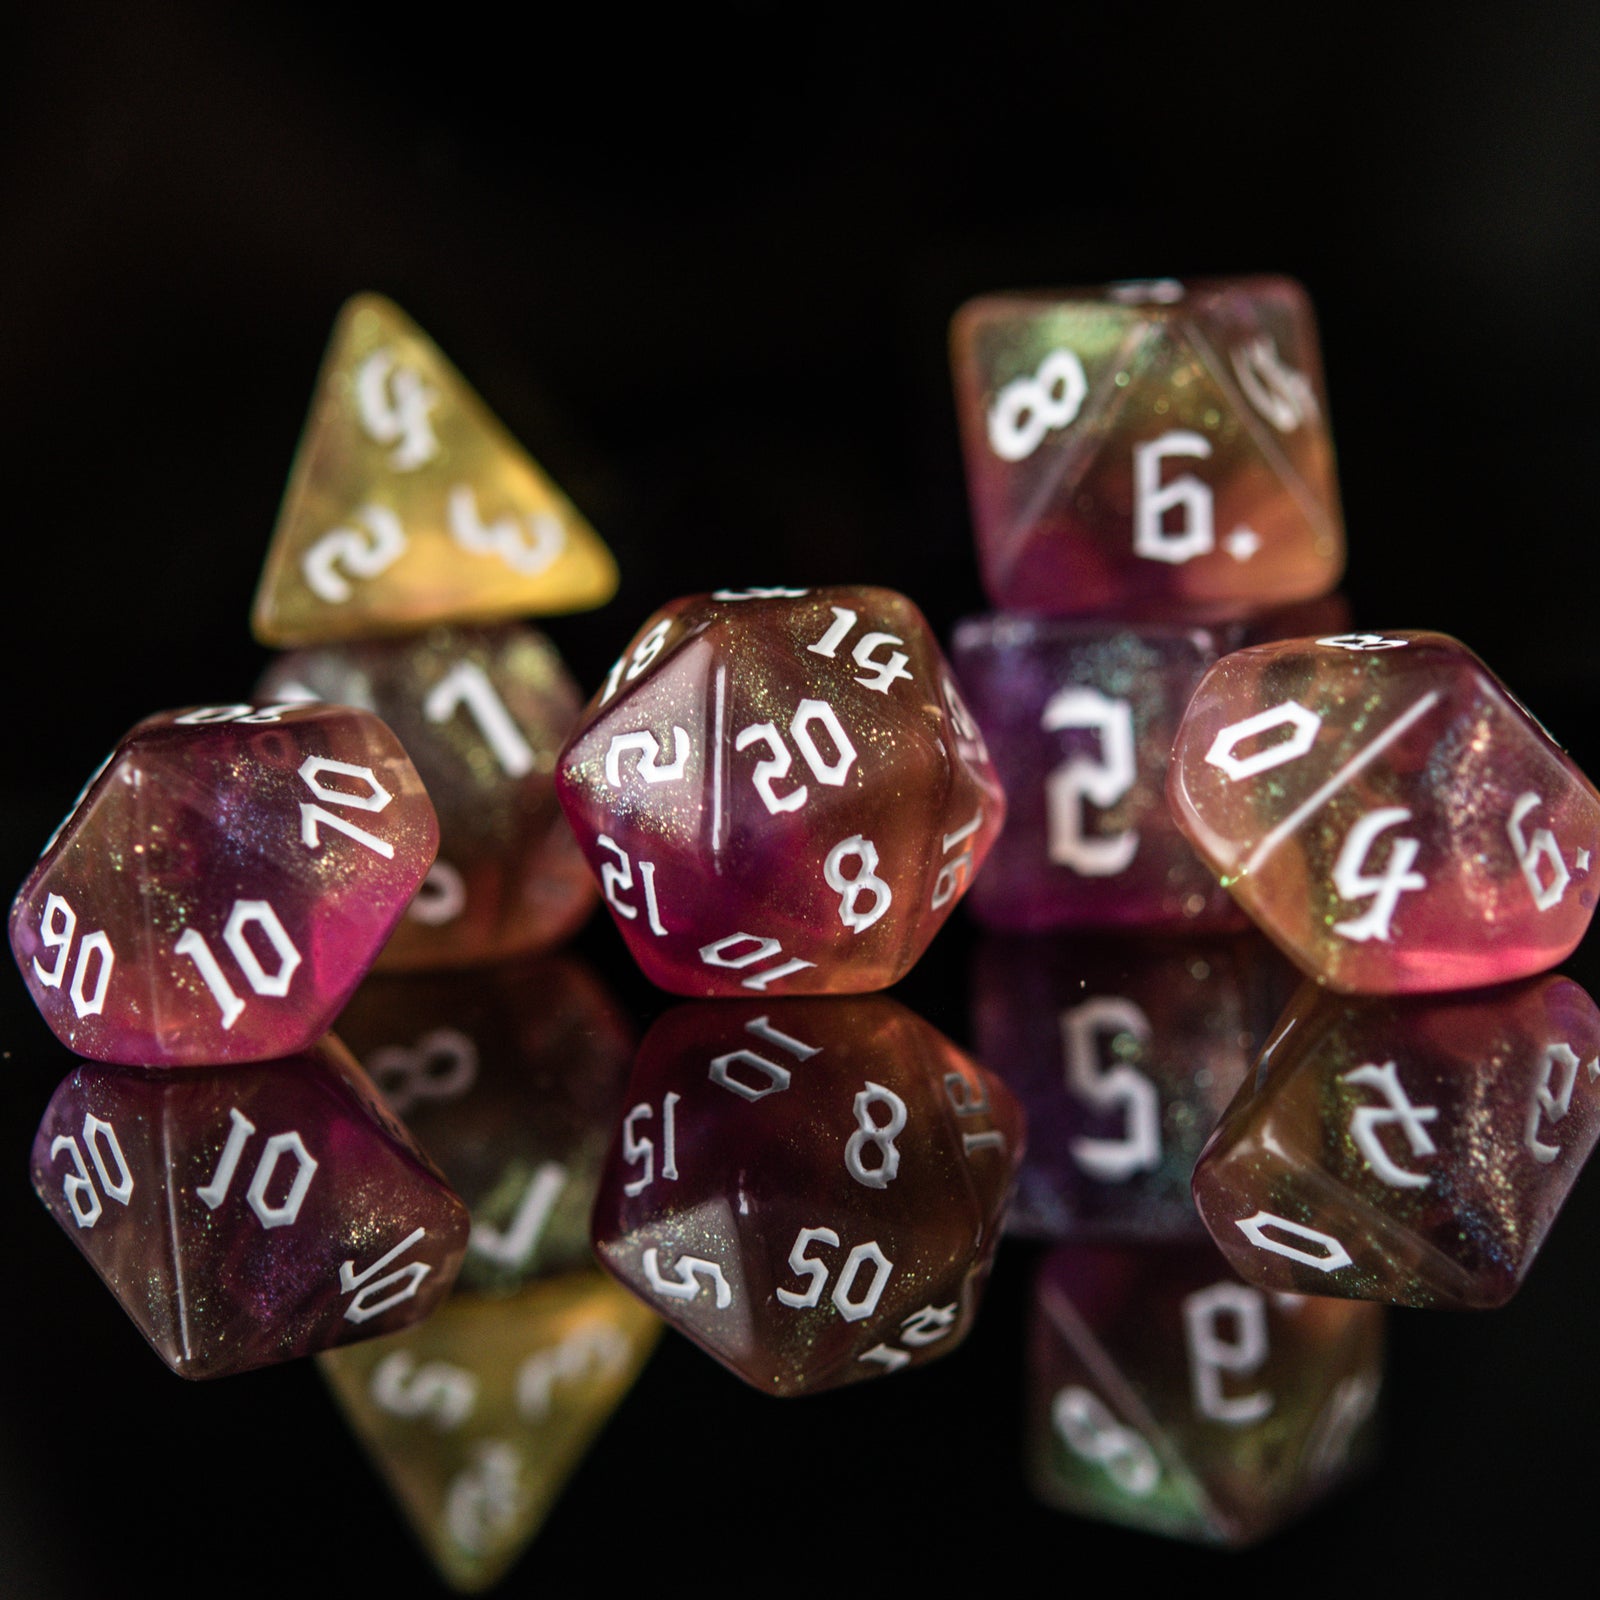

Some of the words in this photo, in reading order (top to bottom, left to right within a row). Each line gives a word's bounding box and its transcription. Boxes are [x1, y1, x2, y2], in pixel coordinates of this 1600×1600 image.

[988, 347, 1088, 462] 8
[303, 505, 407, 604] 2
[807, 606, 914, 695] 14
[735, 698, 857, 815] 20
[1040, 687, 1138, 877] 2
[1204, 700, 1322, 782] 0
[298, 756, 393, 860] 70
[823, 833, 893, 934] 8
[1332, 806, 1427, 943] 4
[32, 893, 115, 1020] 90
[174, 899, 301, 1031] 10
